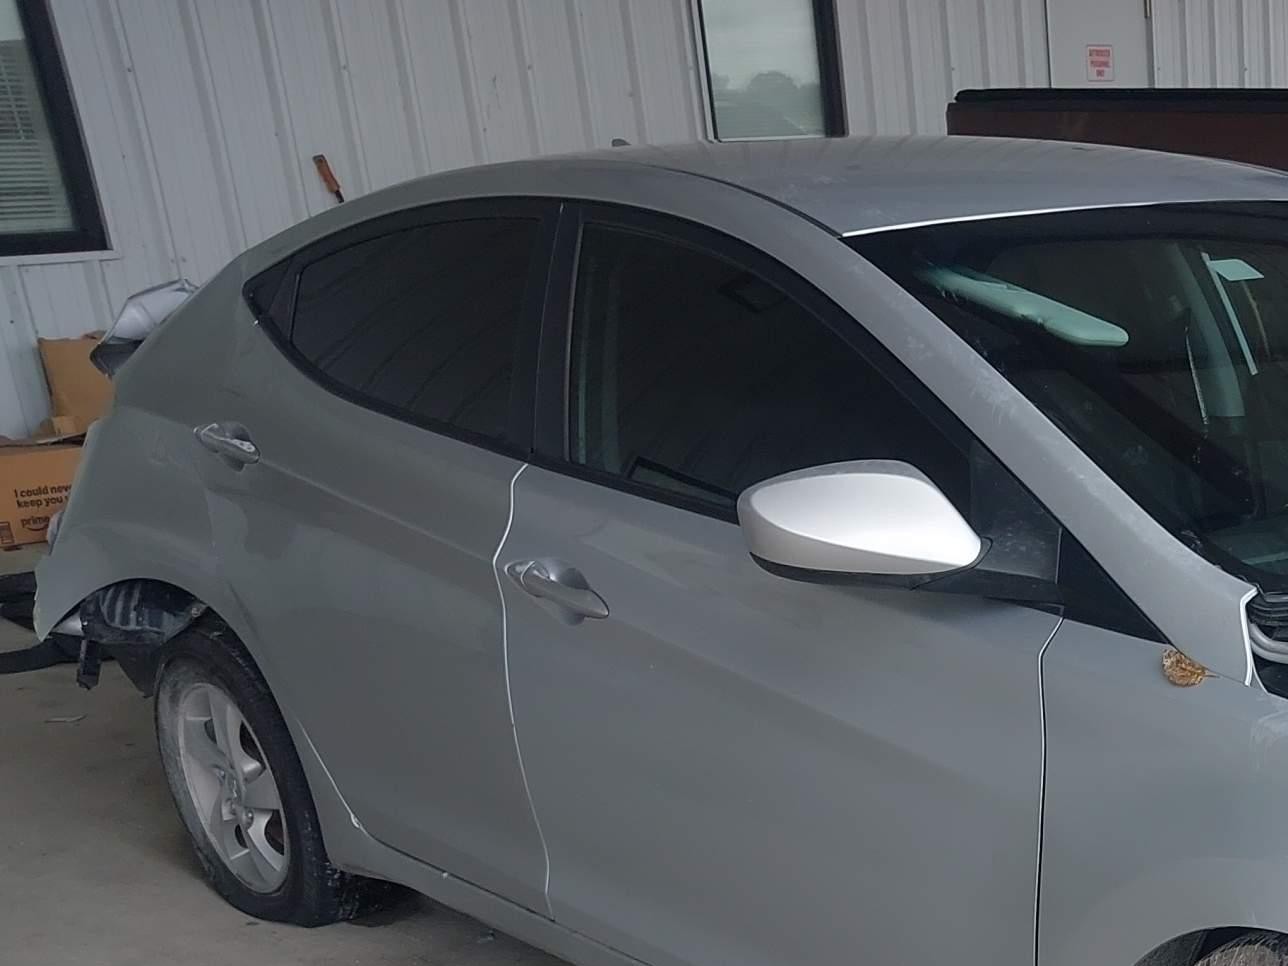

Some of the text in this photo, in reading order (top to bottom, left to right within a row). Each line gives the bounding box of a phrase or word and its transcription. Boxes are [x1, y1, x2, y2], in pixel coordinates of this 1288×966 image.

[14, 484, 72, 498] I could nev
[17, 498, 43, 508] keep
[44, 496, 63, 507] you
